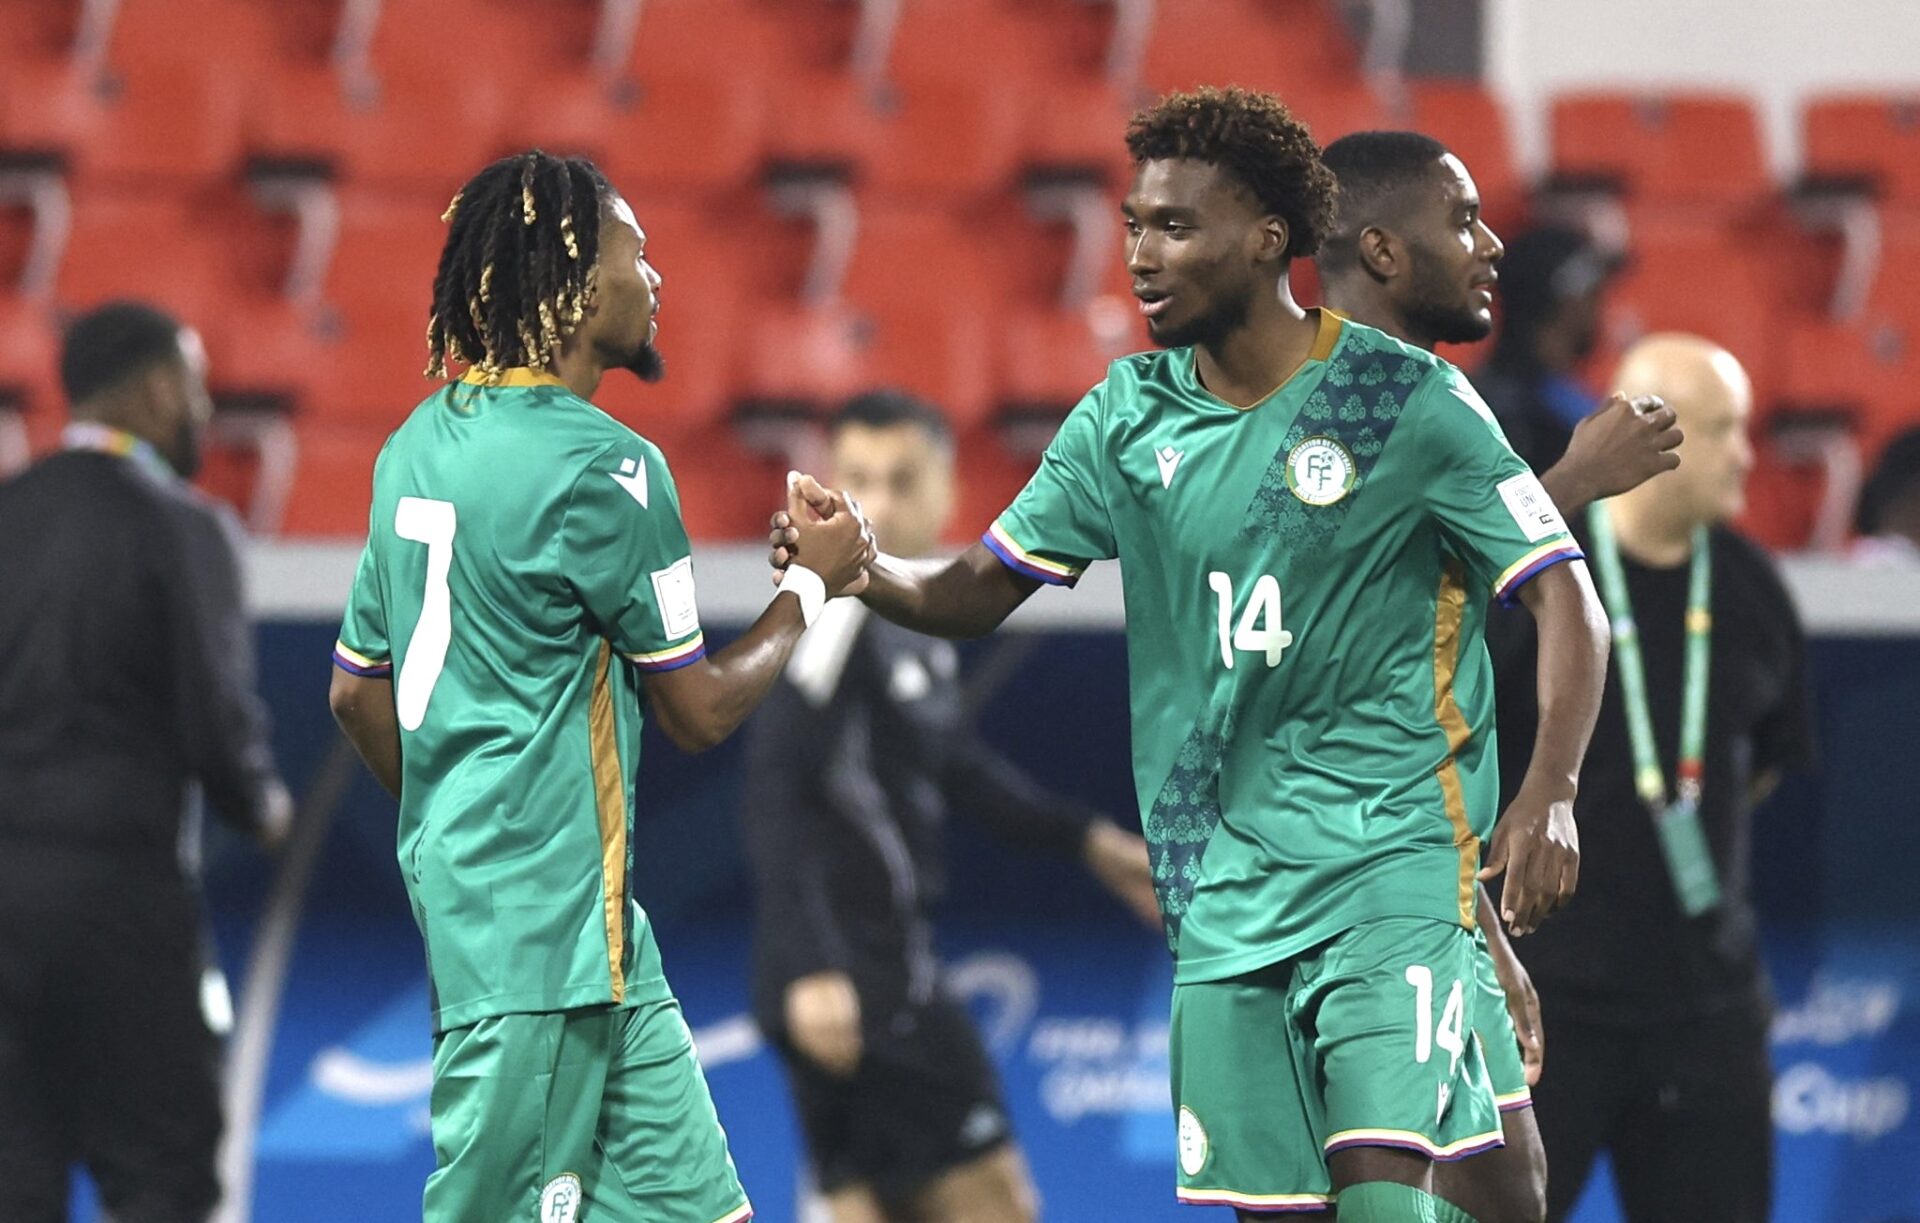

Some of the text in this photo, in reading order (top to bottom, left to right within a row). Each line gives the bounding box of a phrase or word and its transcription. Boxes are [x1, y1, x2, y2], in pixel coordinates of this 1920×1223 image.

[395, 496, 457, 731] 7
[1208, 571, 1293, 670] 14
[1405, 964, 1464, 1077] 14
